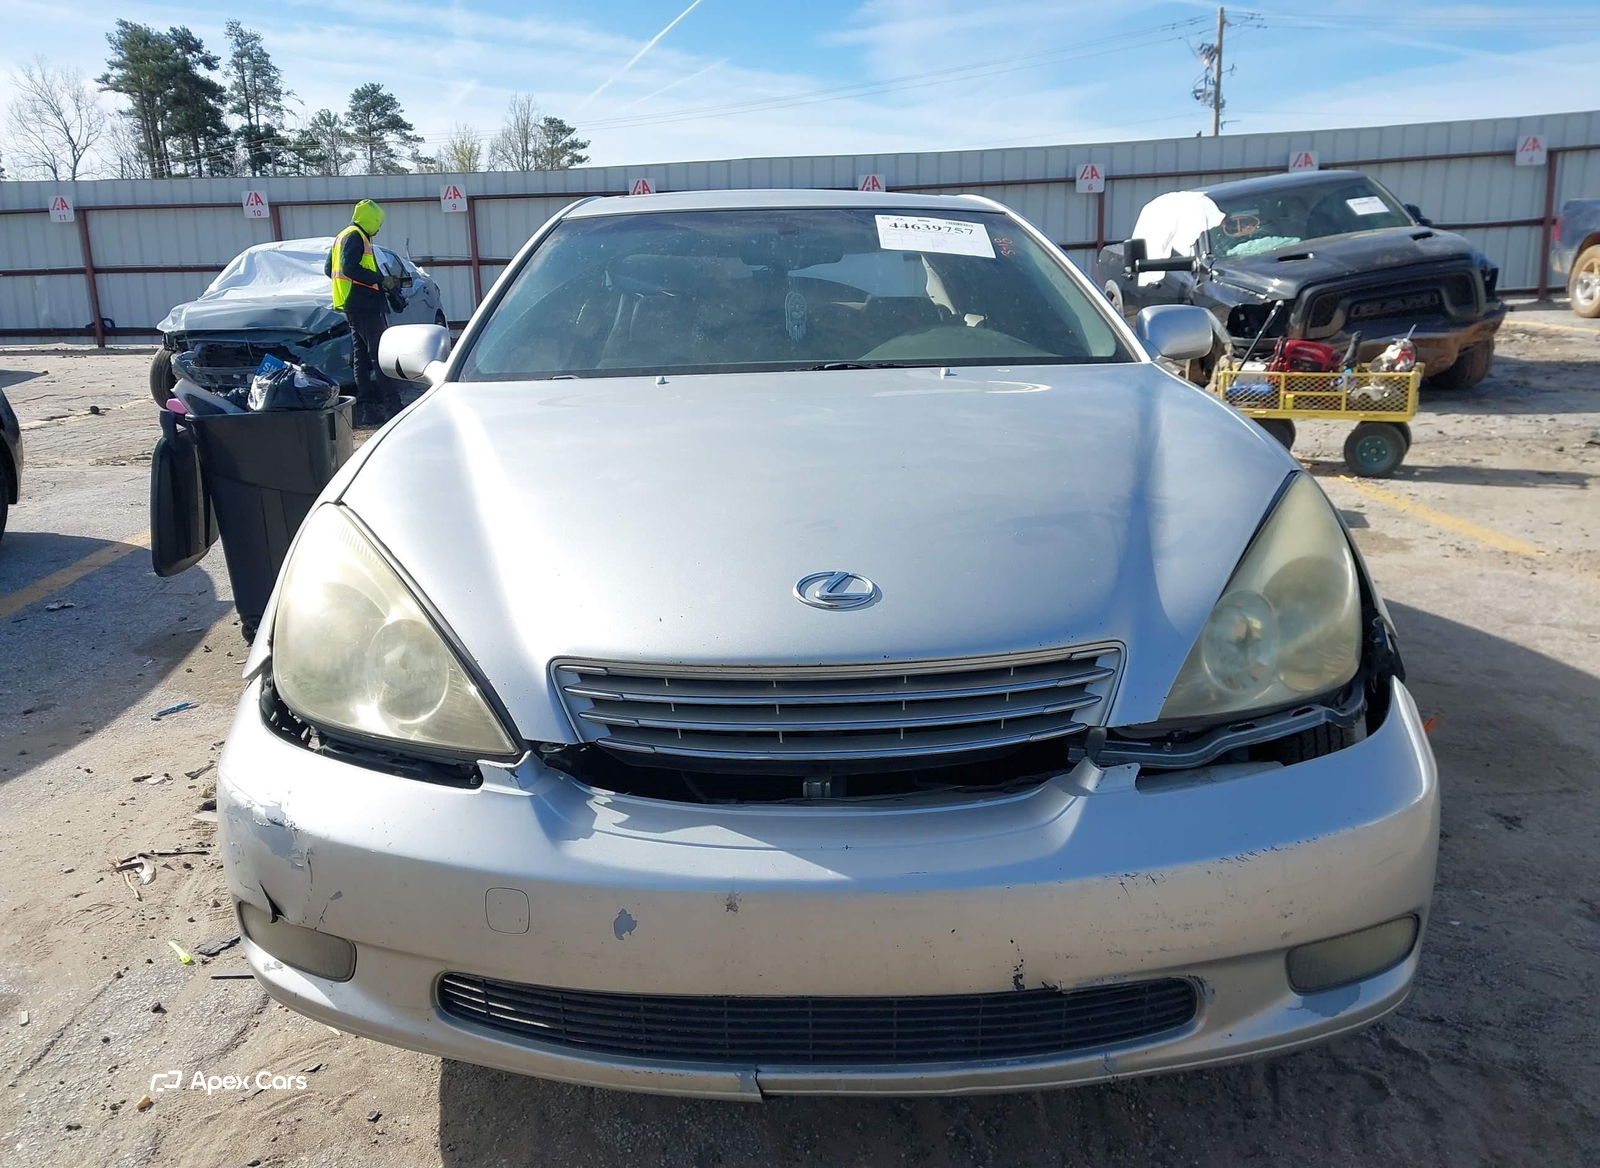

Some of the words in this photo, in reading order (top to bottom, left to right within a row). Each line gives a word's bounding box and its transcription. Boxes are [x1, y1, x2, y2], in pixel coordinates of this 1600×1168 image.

[1087, 183, 1094, 191] 6
[451, 203, 457, 211] 9
[252, 209, 262, 217] 10
[889, 222, 974, 235] 44639757
